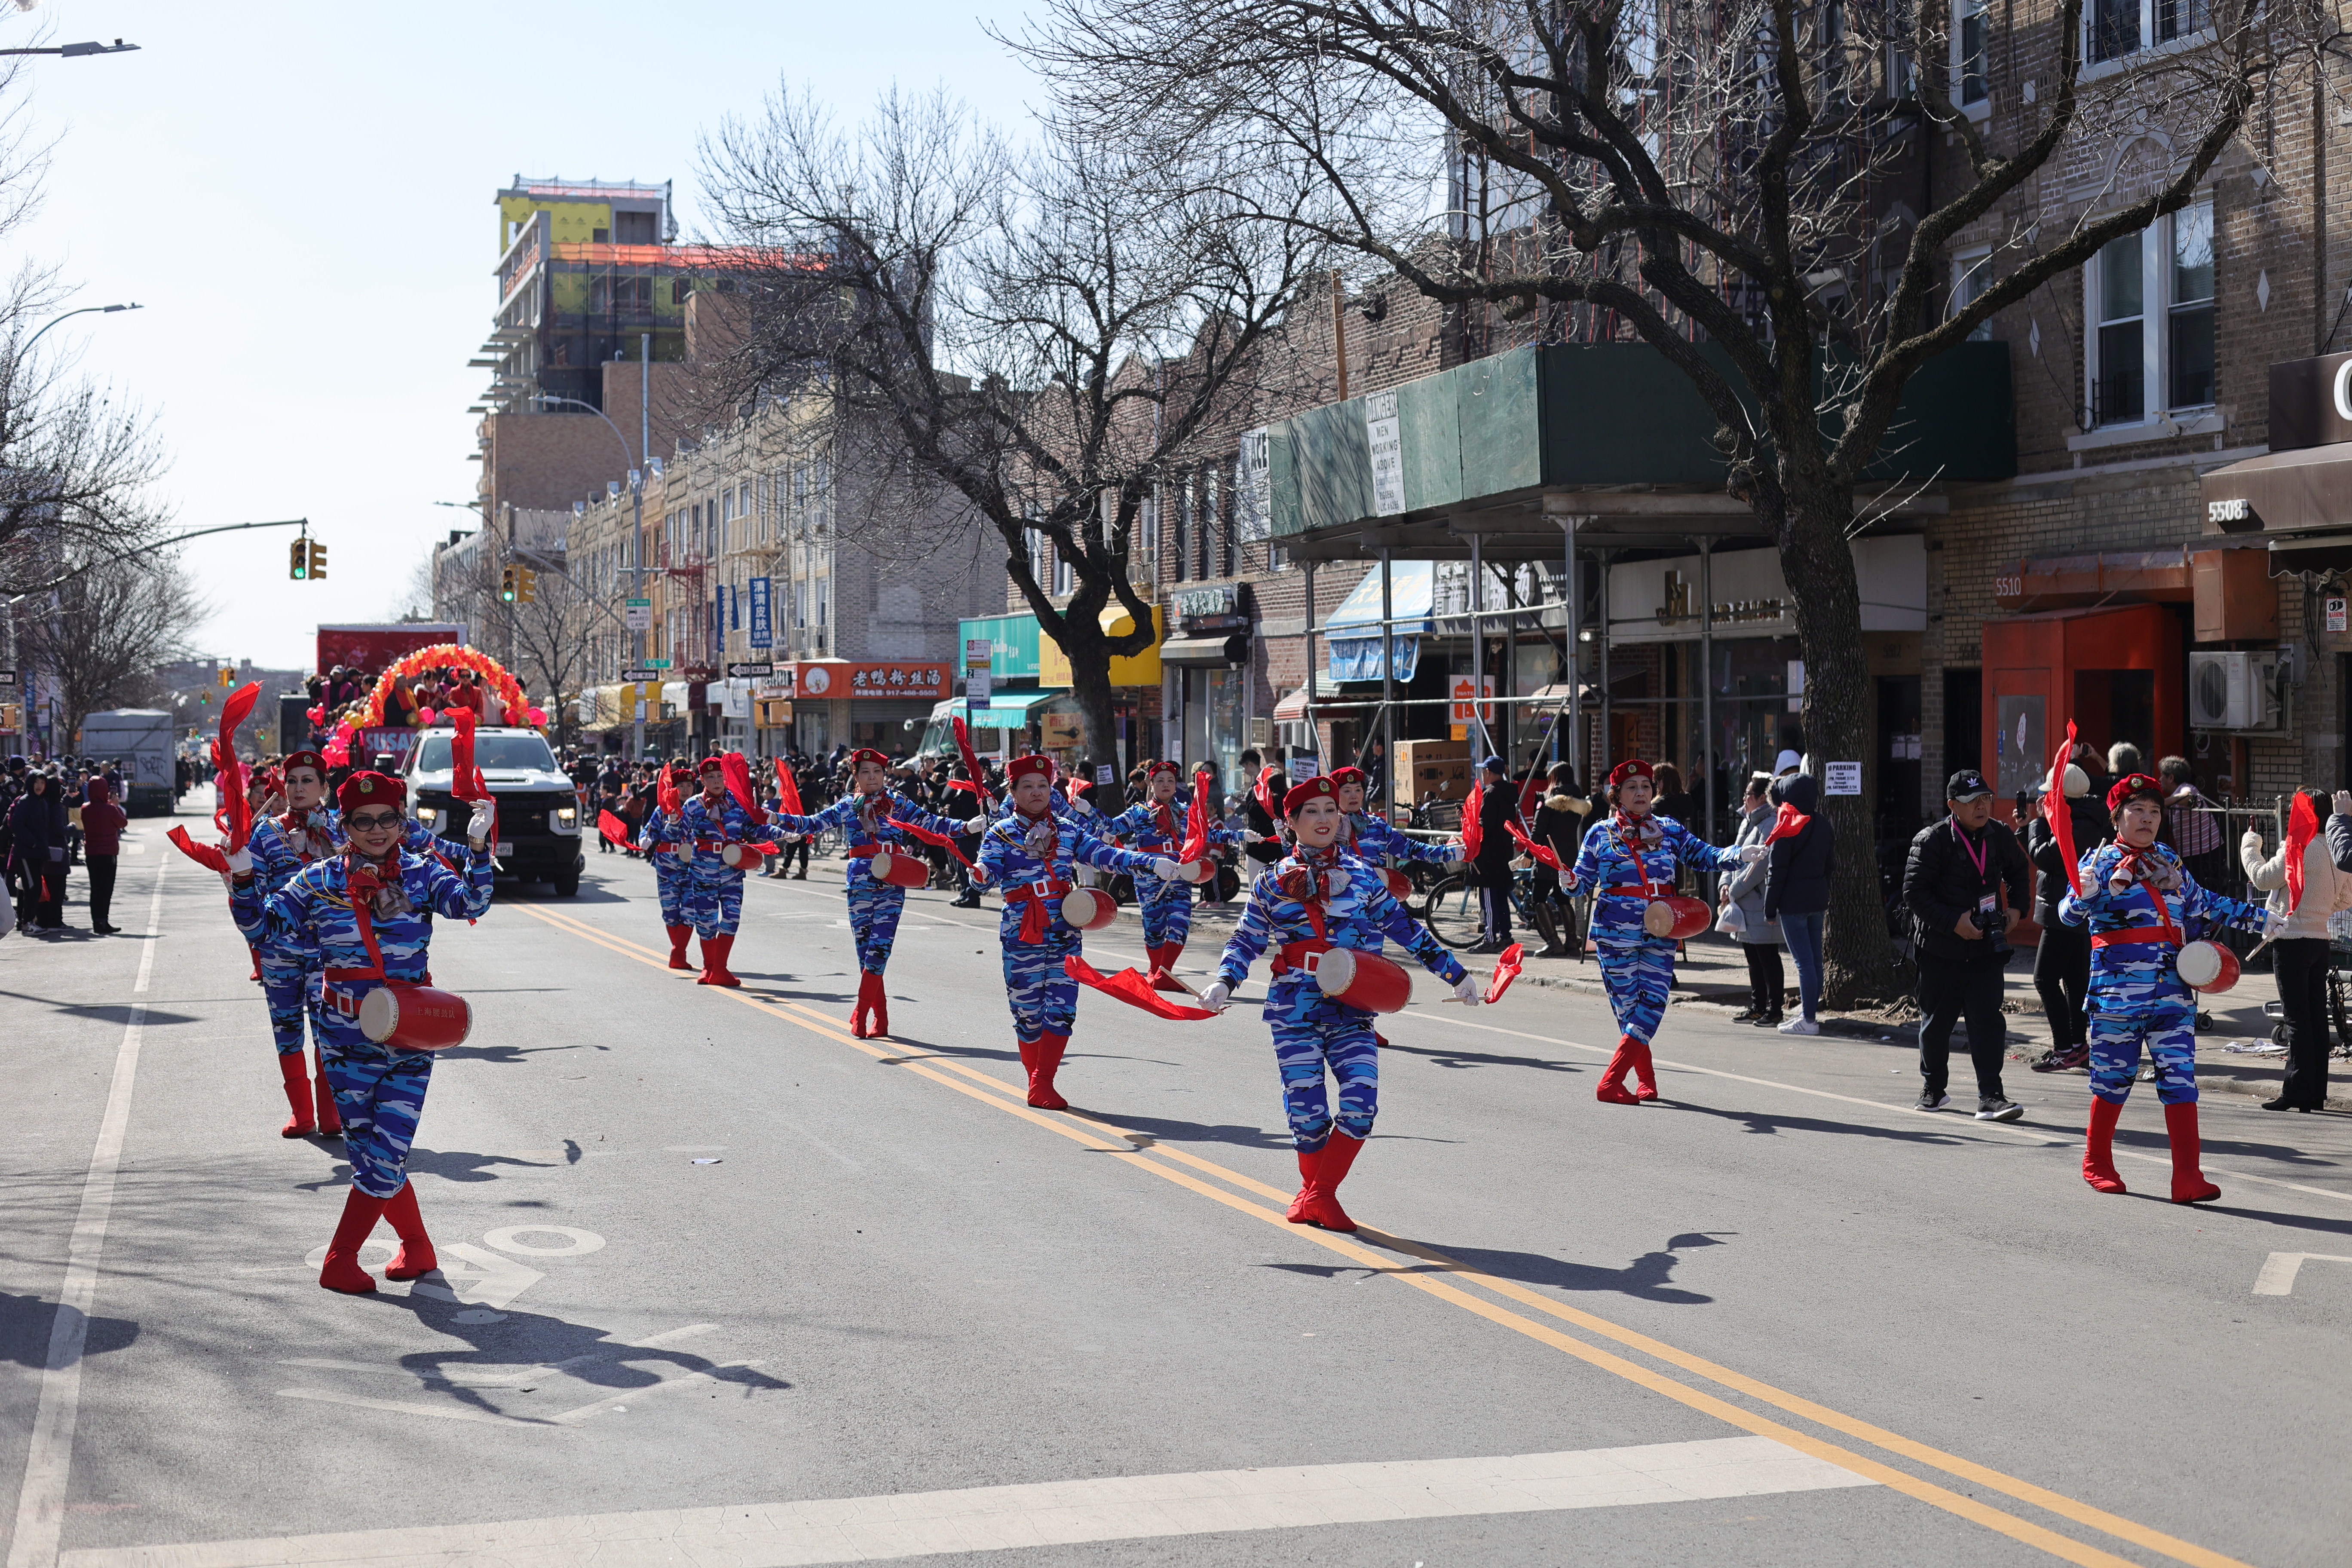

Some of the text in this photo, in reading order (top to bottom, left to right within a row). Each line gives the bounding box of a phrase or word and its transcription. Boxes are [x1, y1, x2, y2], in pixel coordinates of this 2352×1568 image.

[1368, 394, 1396, 422] DANGER
[1376, 425, 1389, 438] MEN
[1371, 439, 1398, 455] WORKING
[1377, 457, 1395, 471] ABOVE
[2208, 499, 2248, 522] 5508
[1436, 561, 1466, 579] Qing Shu
[1996, 577, 2021, 596] 5510
[851, 668, 942, 687] 老鸭粉丝汤
[968, 670, 973, 678] 2
[416, 1006, 456, 1019] 上海腰鼓队
